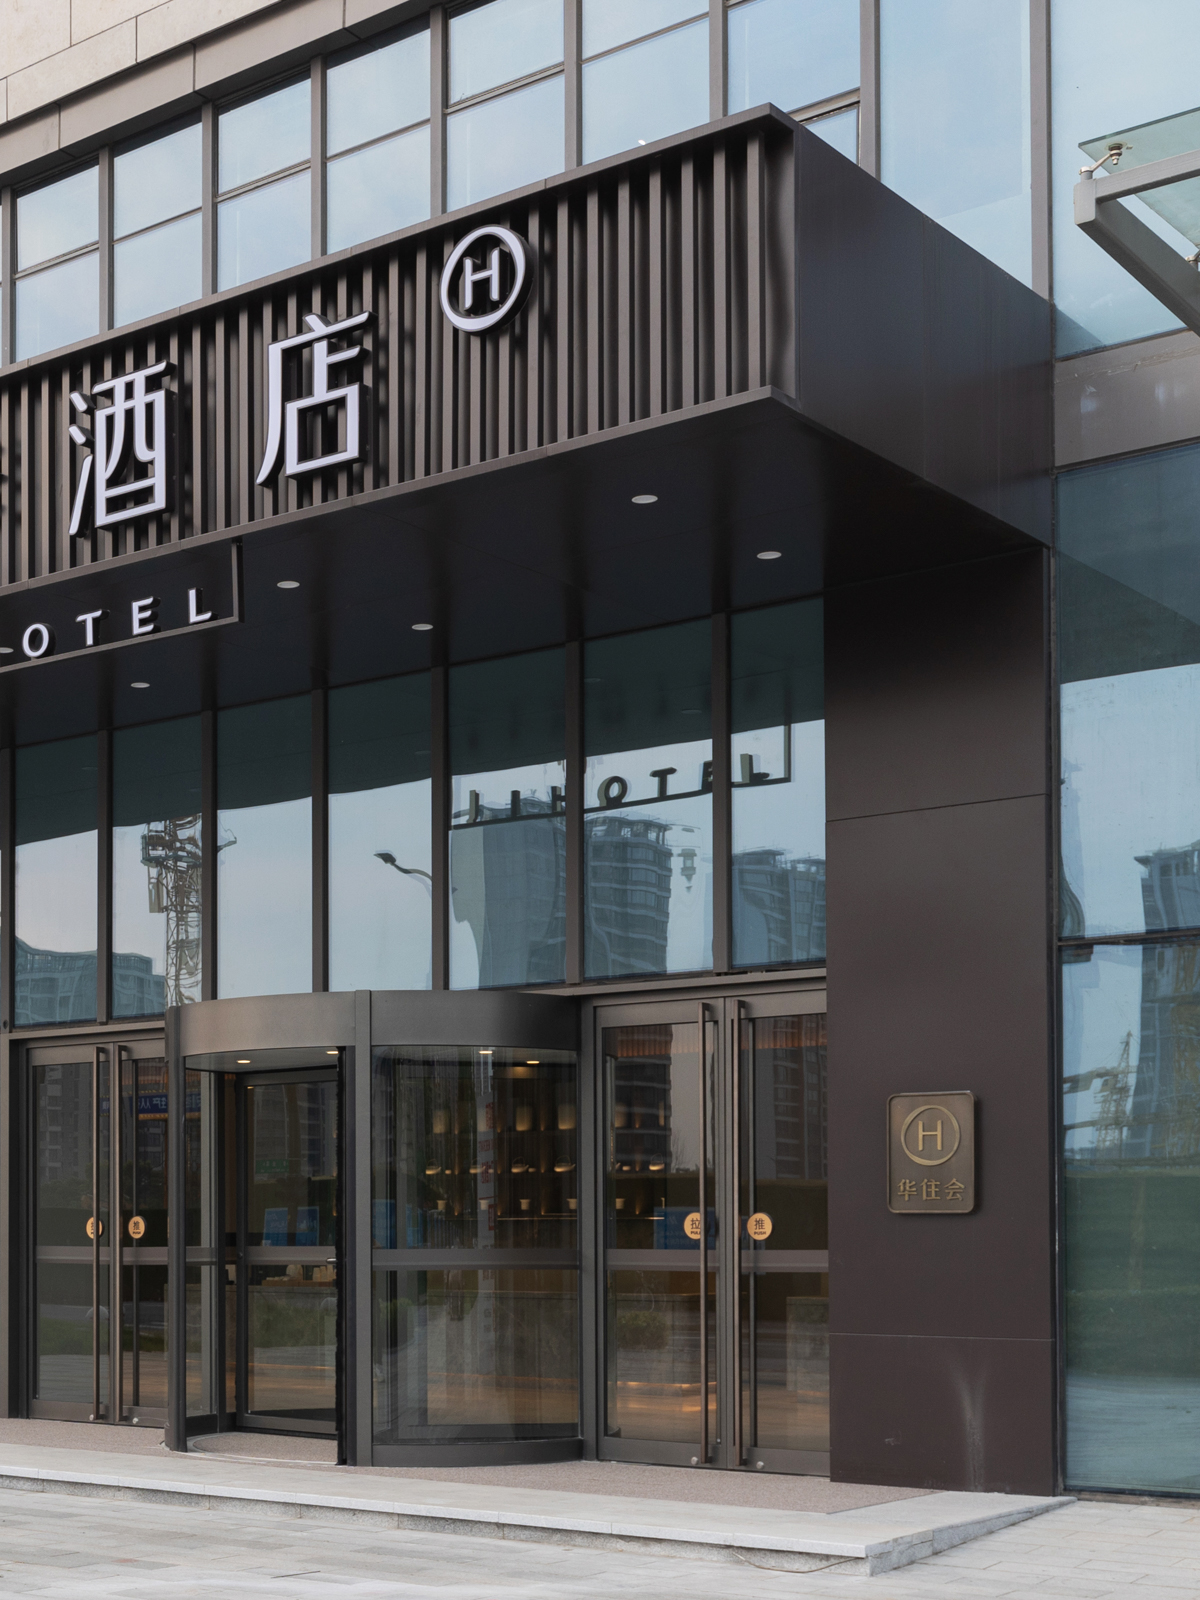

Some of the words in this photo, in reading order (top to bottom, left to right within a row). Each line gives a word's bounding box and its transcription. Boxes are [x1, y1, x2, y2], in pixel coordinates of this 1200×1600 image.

[898, 1178, 965, 1201] 华住会
[133, 1220, 141, 1230] 推
[754, 1218, 766, 1230] 推
